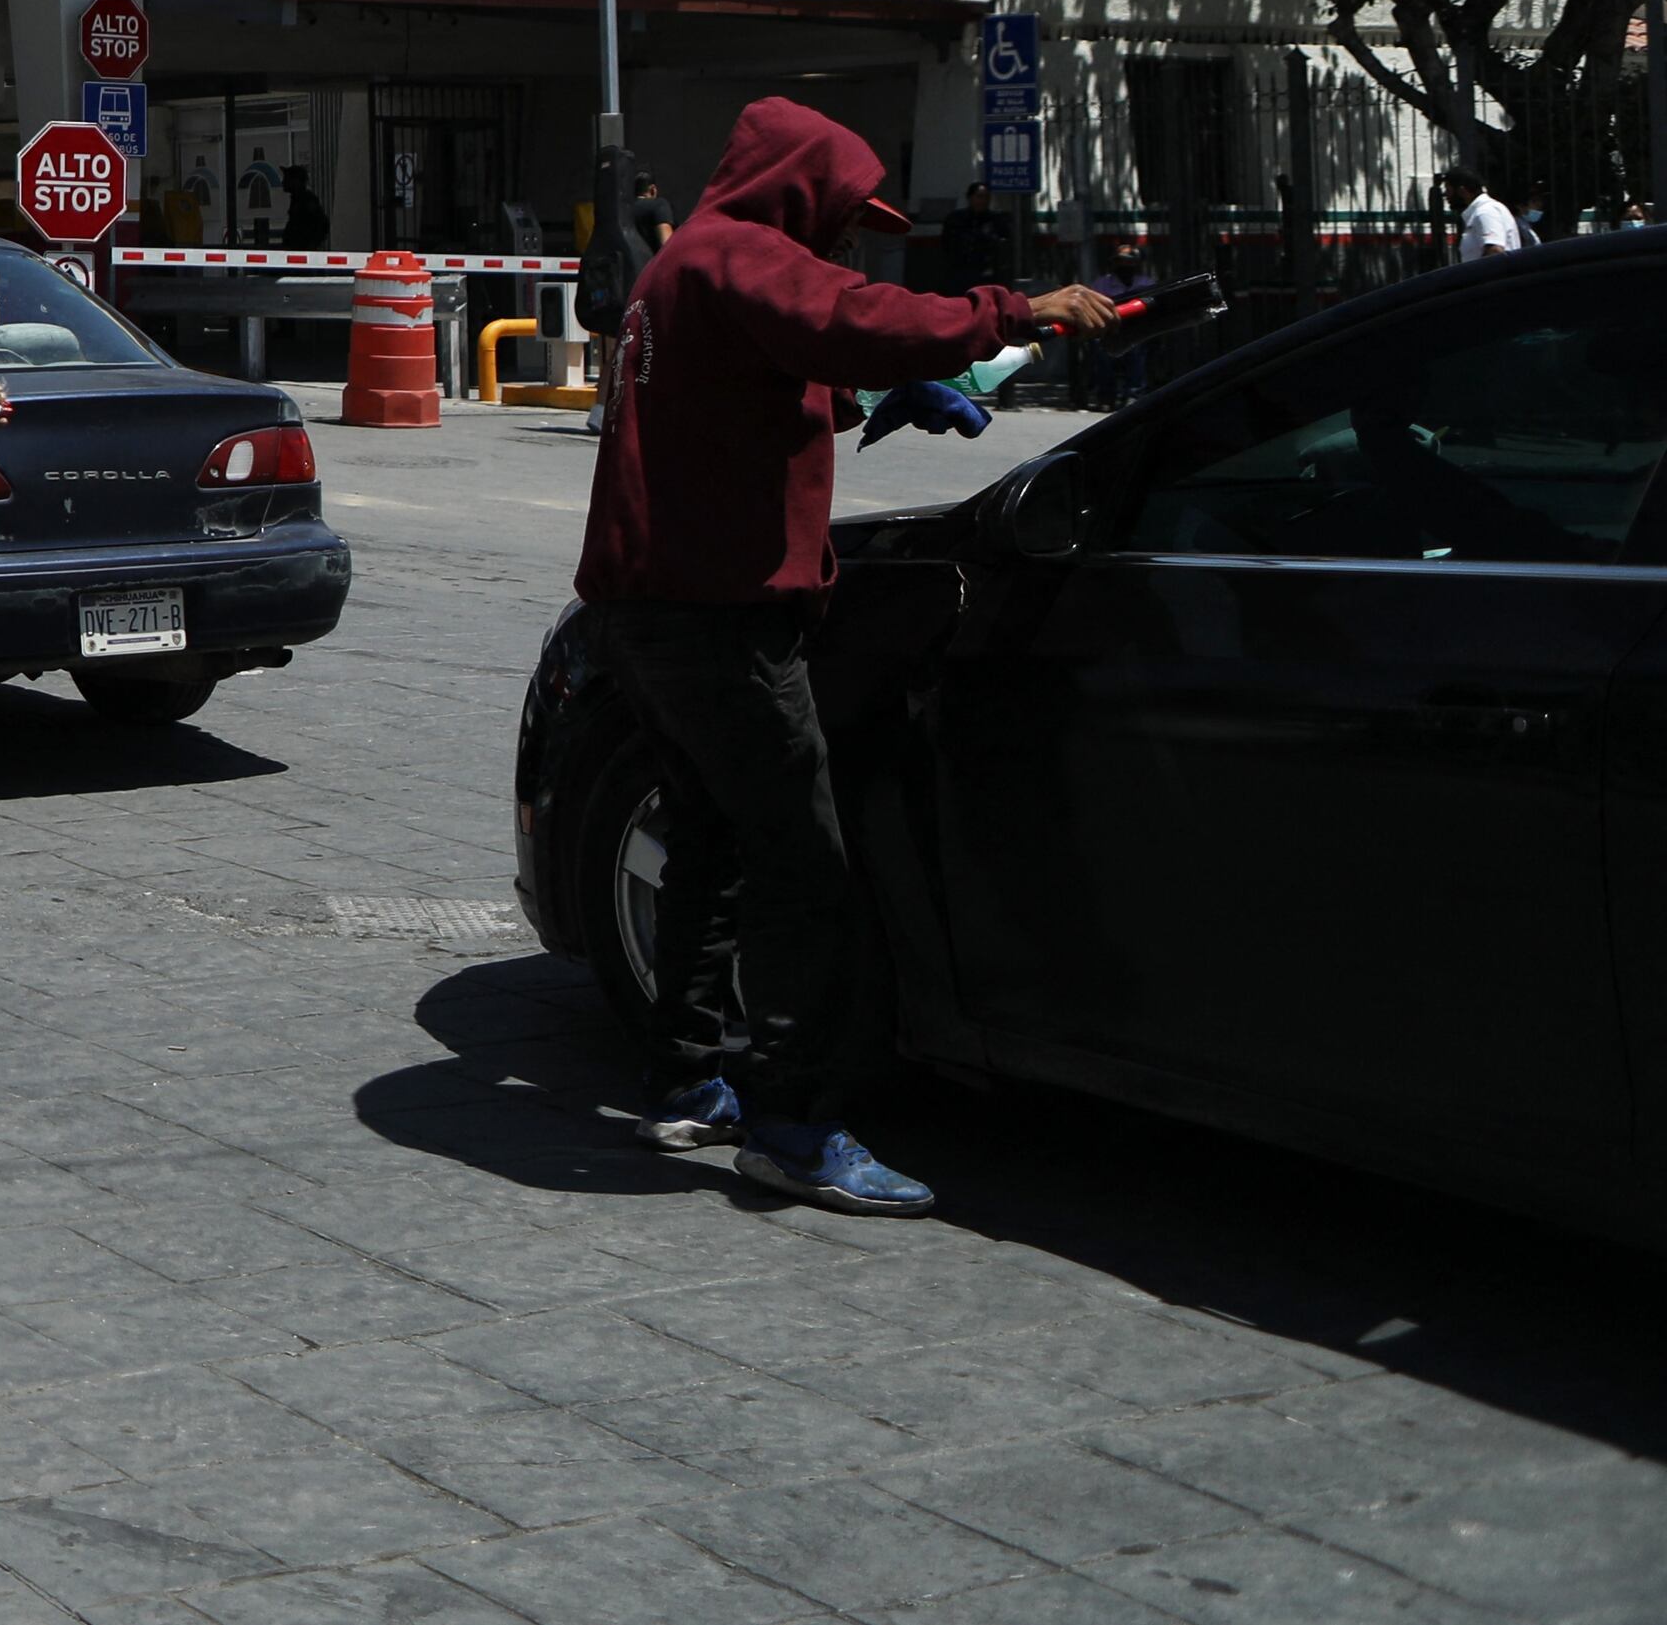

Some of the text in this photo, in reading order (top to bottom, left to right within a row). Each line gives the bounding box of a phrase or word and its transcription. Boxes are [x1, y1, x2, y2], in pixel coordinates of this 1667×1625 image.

[91, 14, 139, 34] ALTO
[91, 39, 140, 58] STOP
[123, 132, 136, 142] DE
[36, 152, 111, 179] ALTO
[34, 185, 112, 212] STOP
[44, 471, 171, 480] COROLLA
[104, 591, 159, 603] CHIHUAHUA
[85, 604, 181, 637] DVE-271-B
